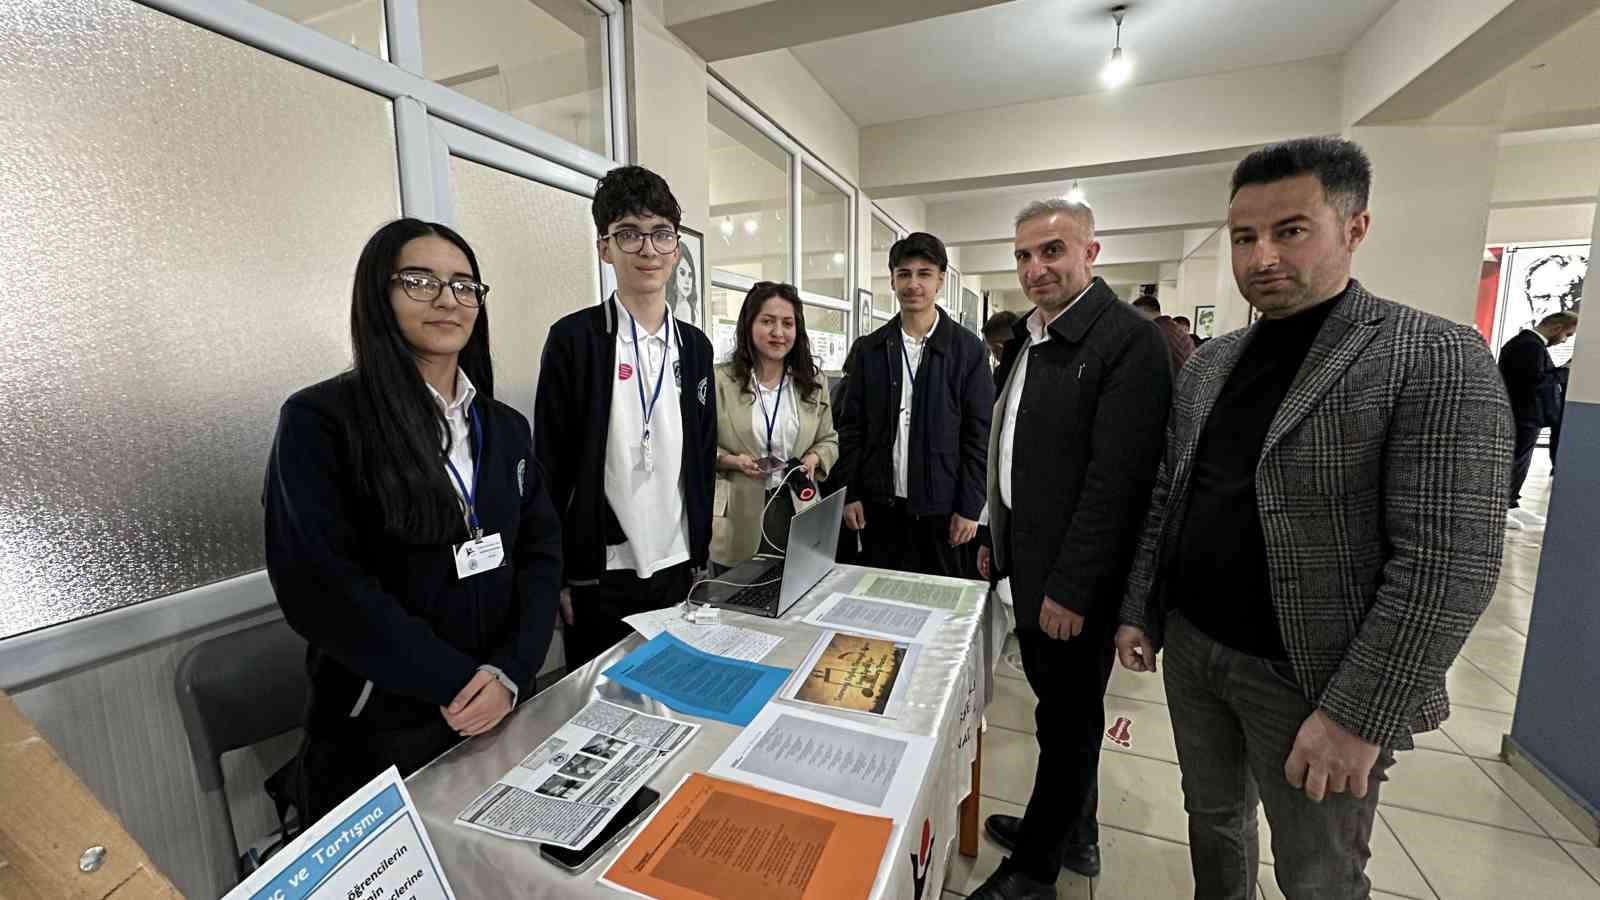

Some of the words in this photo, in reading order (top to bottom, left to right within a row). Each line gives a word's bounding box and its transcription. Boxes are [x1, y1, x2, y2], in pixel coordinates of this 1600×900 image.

[288, 867, 310, 887] ve
[312, 807, 384, 864] Tartışma
[347, 845, 408, 900] öğrencilerin
